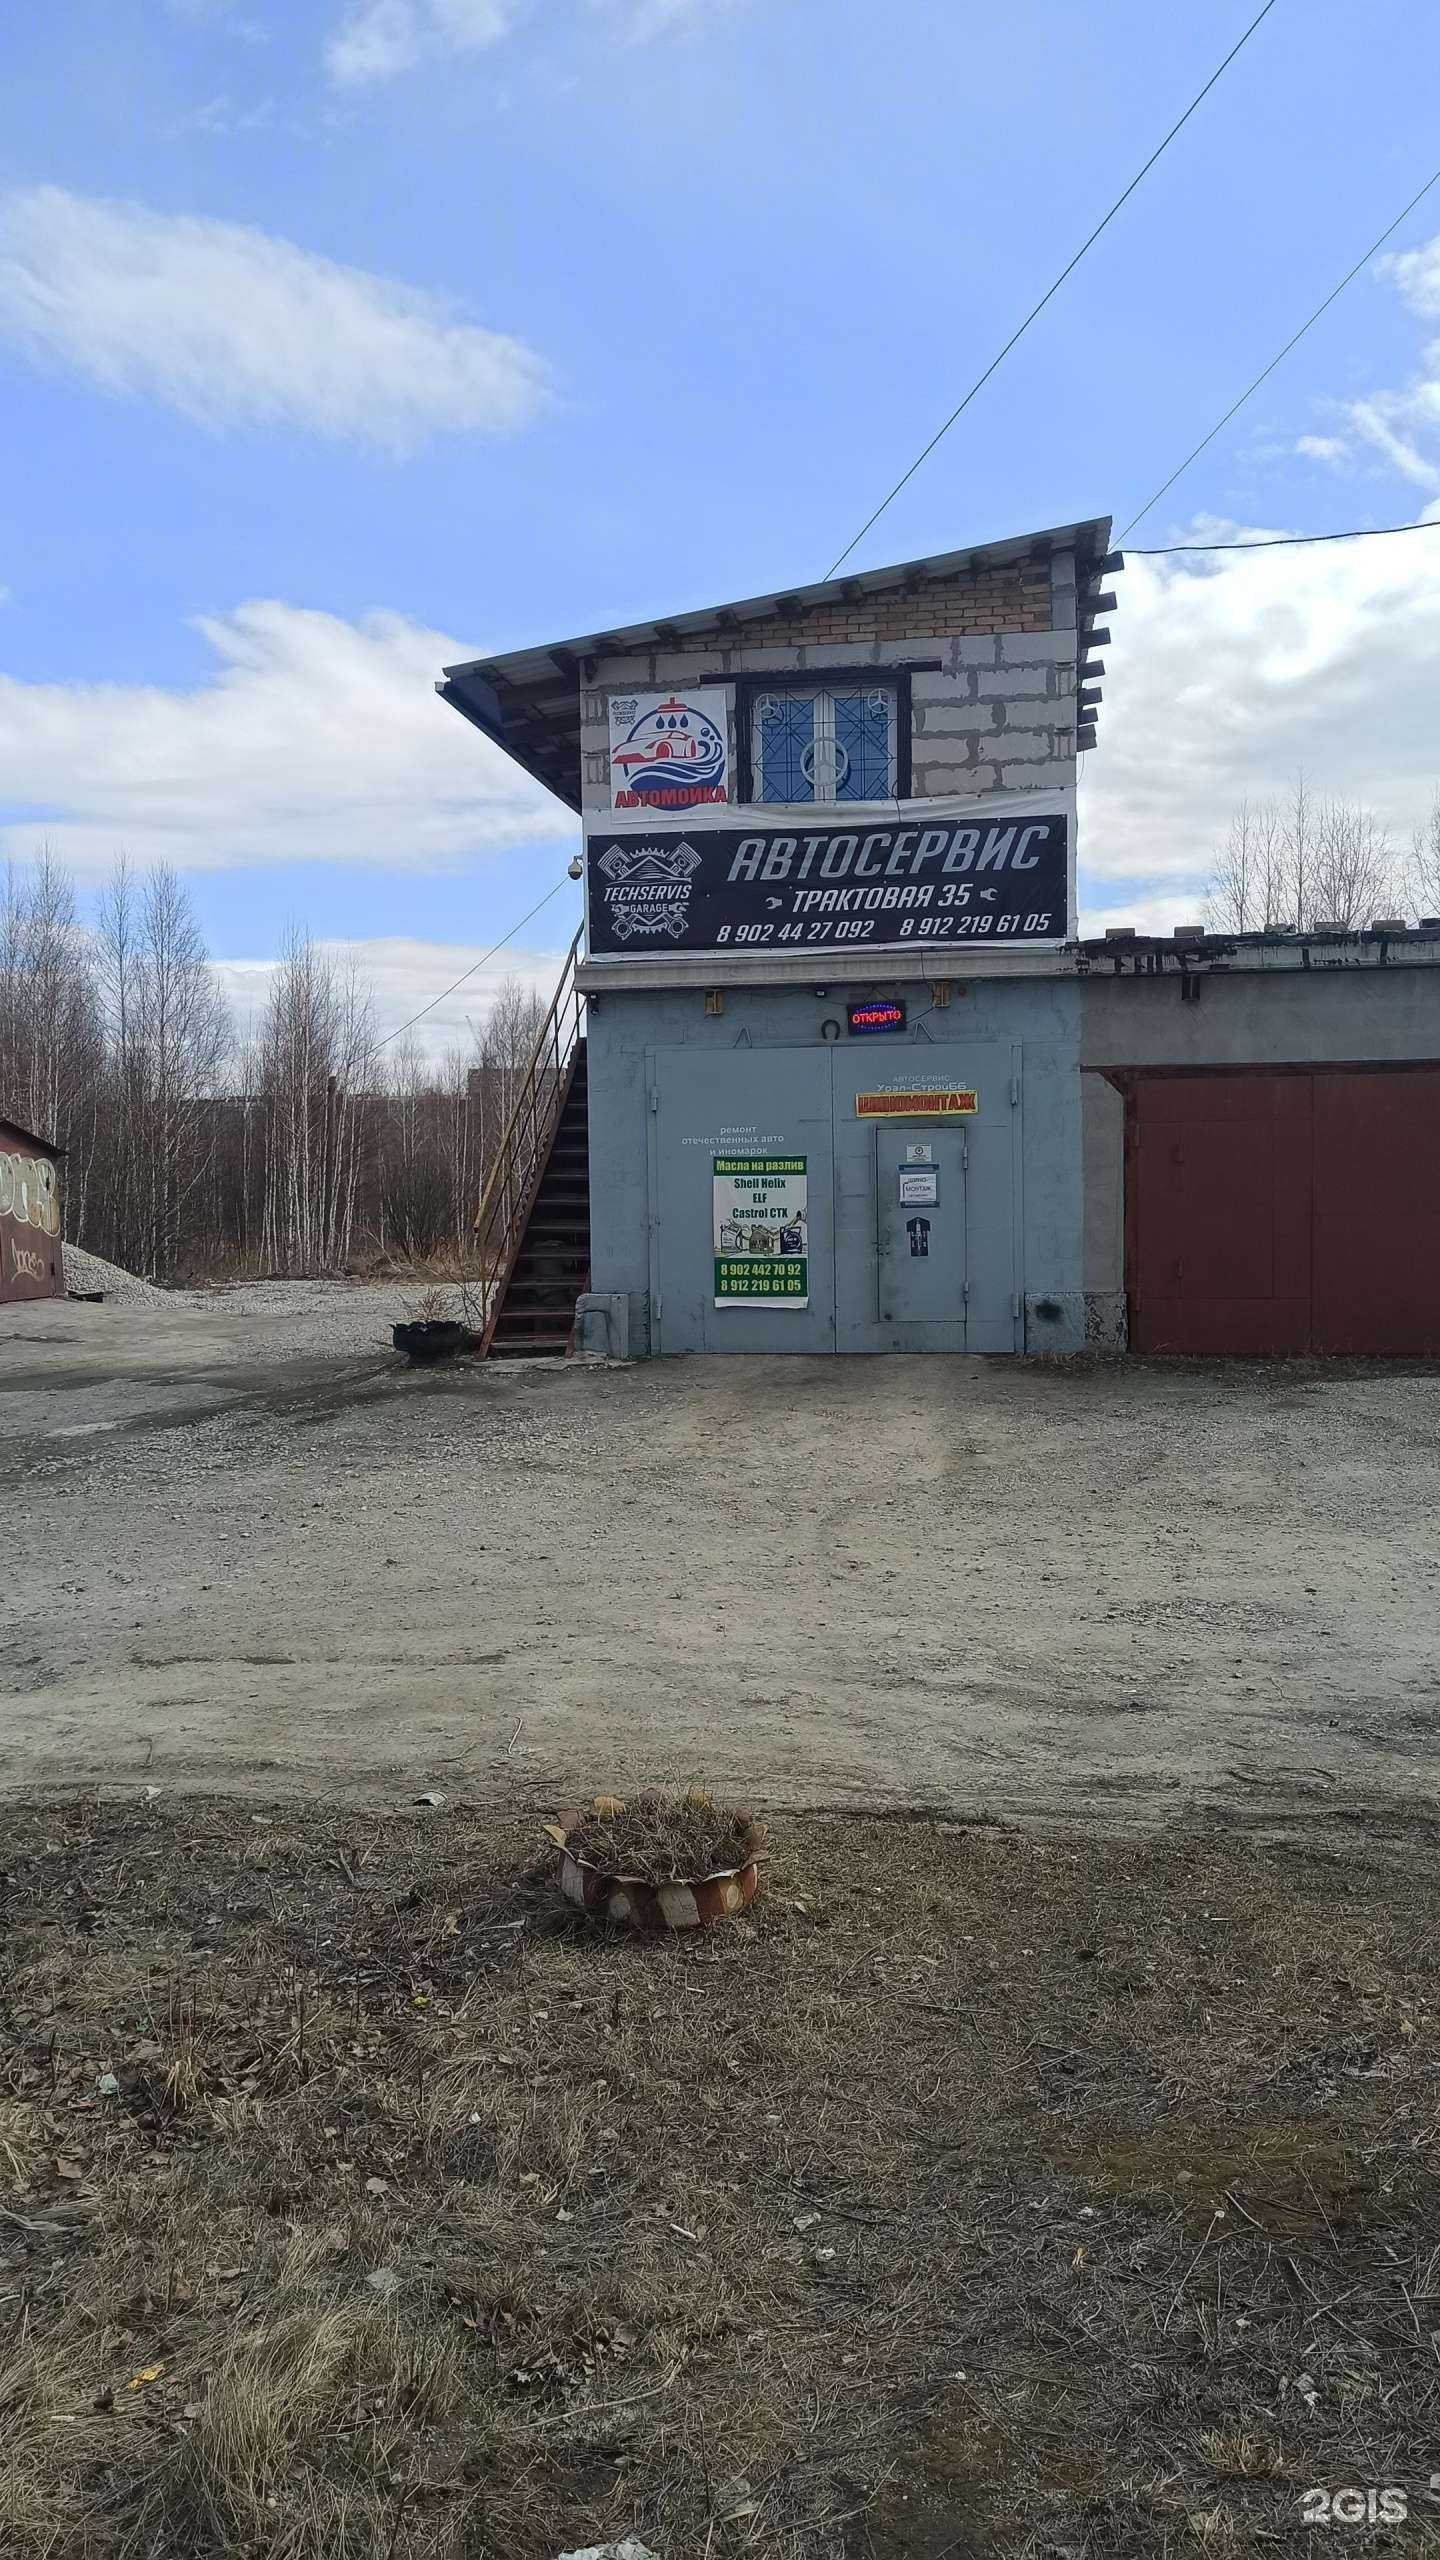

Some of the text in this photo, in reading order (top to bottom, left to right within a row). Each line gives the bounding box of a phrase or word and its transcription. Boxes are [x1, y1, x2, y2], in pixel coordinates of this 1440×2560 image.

[615, 785, 728, 808] АВТОМОЙКА
[727, 826, 1050, 882] АВТОСЕРВИС
[604, 885, 692, 902] TECHSERVIS
[792, 883, 974, 913] ТРАКТОВАЯ 35
[630, 903, 669, 913] GARAGE
[899, 913, 1052, 936] 8 912 219 61 05
[716, 920, 875, 942] 8 902 44 27 092
[852, 1010, 901, 1024] ОТКРЫТО
[858, 1093, 976, 1113] ШИНОМОНТАЖ
[720, 1126, 758, 1136] ремонт
[681, 1135, 785, 1146] отечественных авто
[716, 1160, 805, 1172] Масла на разлив
[734, 1177, 787, 1189] Shell Helix
[752, 1192, 768, 1204] ELF
[732, 1207, 768, 1219] Castrol
[721, 1264, 801, 1276] 8 902 442 70 92
[721, 1280, 801, 1292] 8 912 219 61 05
